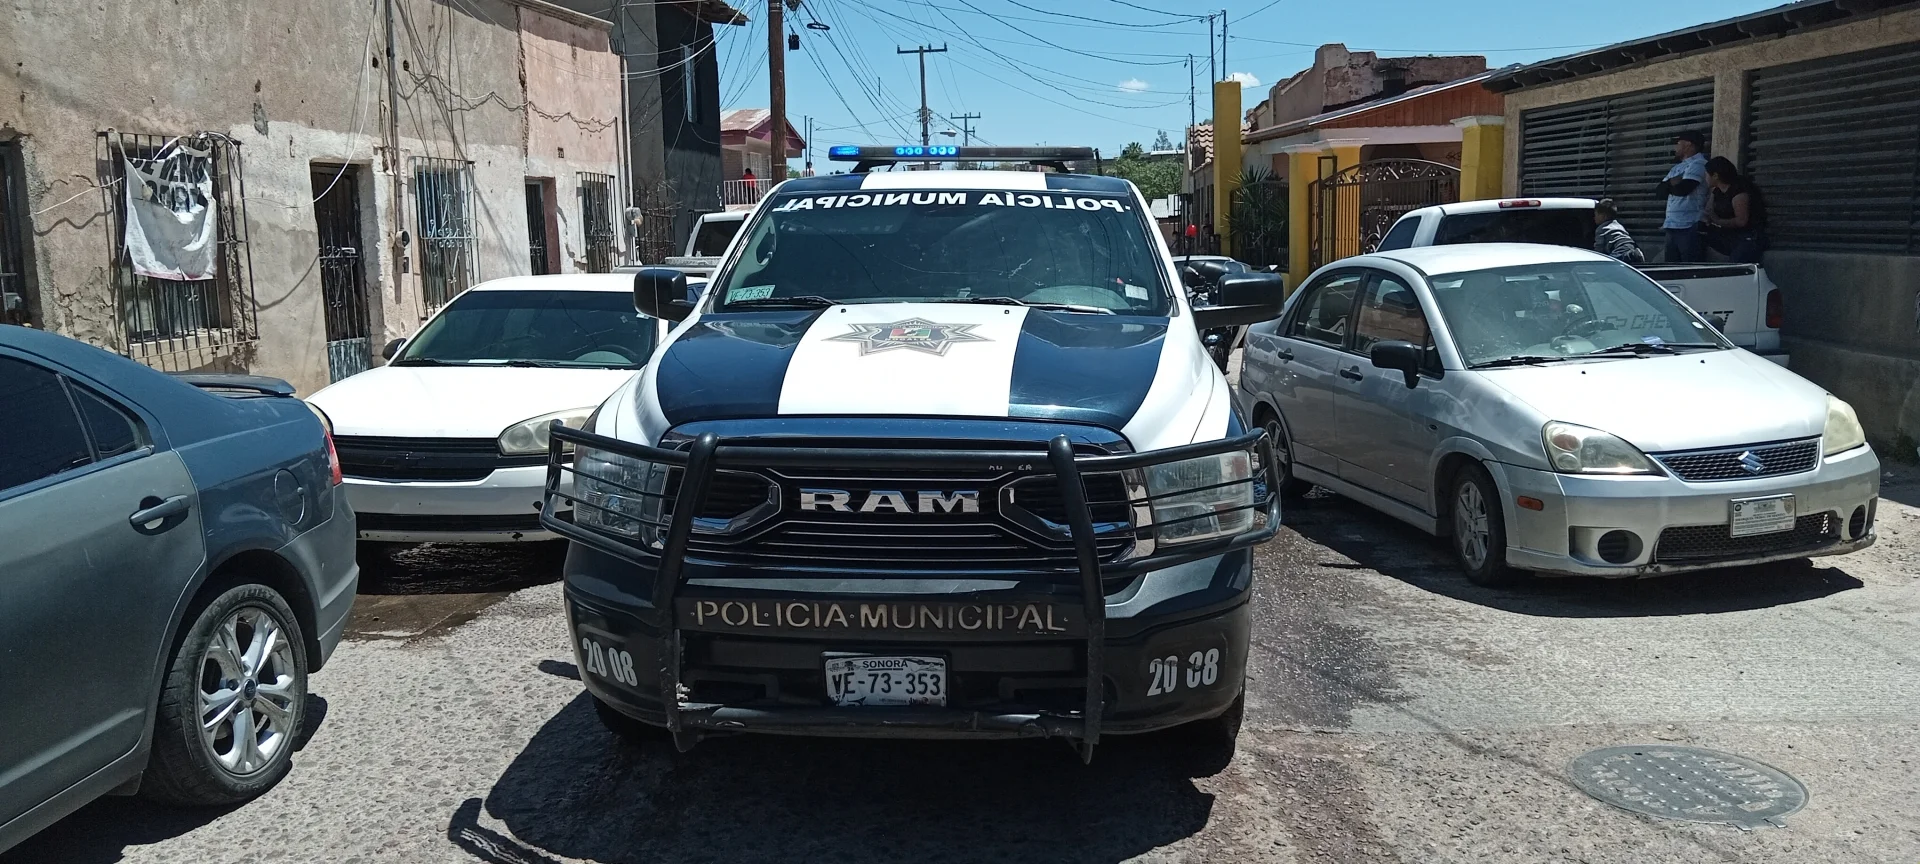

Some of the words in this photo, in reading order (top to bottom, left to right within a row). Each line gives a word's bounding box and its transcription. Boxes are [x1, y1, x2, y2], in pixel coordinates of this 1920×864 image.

[799, 488, 980, 513] RAM
[696, 601, 849, 628] POLICIA
[860, 603, 1067, 632] MUNICIPAL
[862, 659, 908, 668] SONORA
[831, 672, 941, 696] VE-73-353
